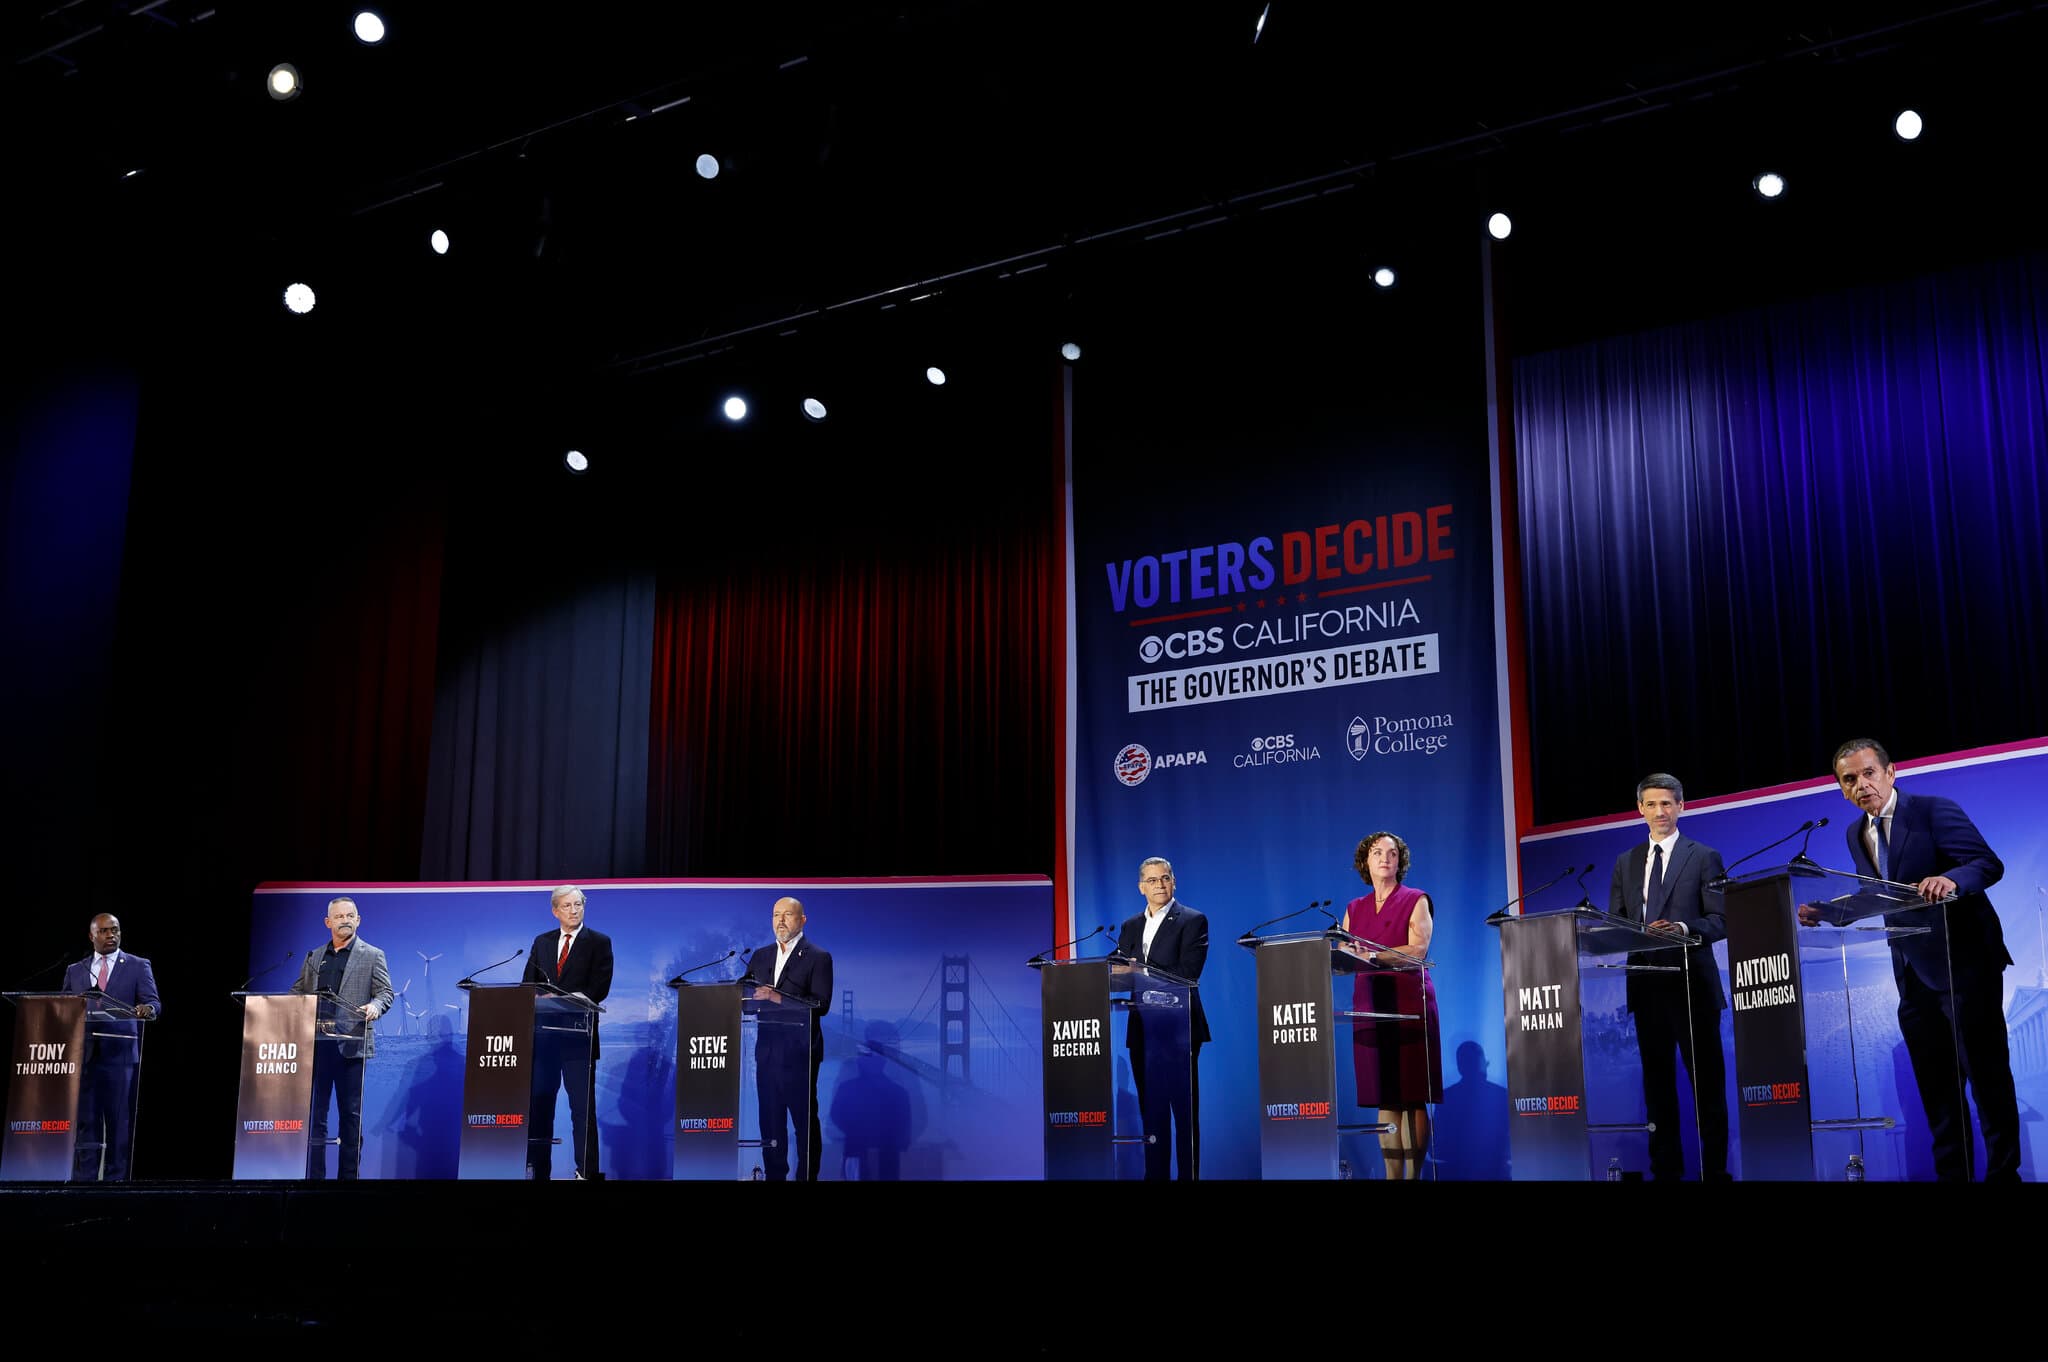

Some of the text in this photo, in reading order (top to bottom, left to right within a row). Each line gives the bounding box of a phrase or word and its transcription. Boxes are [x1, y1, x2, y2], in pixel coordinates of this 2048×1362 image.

[1106, 504, 1455, 612] VOTERS DECIDE
[1164, 598, 1419, 659] CBS CALIFORNIA
[1137, 676, 1177, 706] THE
[1335, 642, 1427, 680] DEBATE
[1373, 713, 1454, 735] Pomona
[1264, 734, 1294, 749] CBS
[1374, 733, 1448, 755] College
[1154, 750, 1208, 769] APAPA
[1233, 746, 1320, 769] CALIFORNIA
[1735, 953, 1790, 988] ANTONIO
[1519, 984, 1562, 1011] MATT
[1733, 983, 1796, 1012] VILLARAIGOSA
[1273, 1002, 1317, 1026] KATIE
[1521, 1012, 1563, 1031] MAHAN
[1052, 1018, 1100, 1041] XAVIER
[1273, 1027, 1318, 1044] PORTER
[29, 1043, 66, 1061] TONY
[258, 1043, 298, 1061] CHAD
[486, 1035, 514, 1053] TOM
[689, 1036, 728, 1055] STEVE
[1052, 1042, 1101, 1057] BECERRA
[16, 1062, 76, 1075] THURMOND
[255, 1061, 298, 1075] BIANCO
[479, 1055, 518, 1068] STEYER
[690, 1056, 726, 1070] HILTON
[1742, 1082, 1801, 1102] VOTERS DECIDE
[1266, 1101, 1330, 1117] VOTERS DECIDE
[1515, 1096, 1579, 1112] VOTERS DECIDE
[10, 1119, 71, 1132] VOTERS DECIDE
[243, 1119, 303, 1132] VOTERS DECIDE
[468, 1114, 524, 1125] VOTERS DECIDE
[680, 1117, 734, 1129] VOTERS DECIDE
[1049, 1110, 1107, 1125] VOTERS DECIDE
